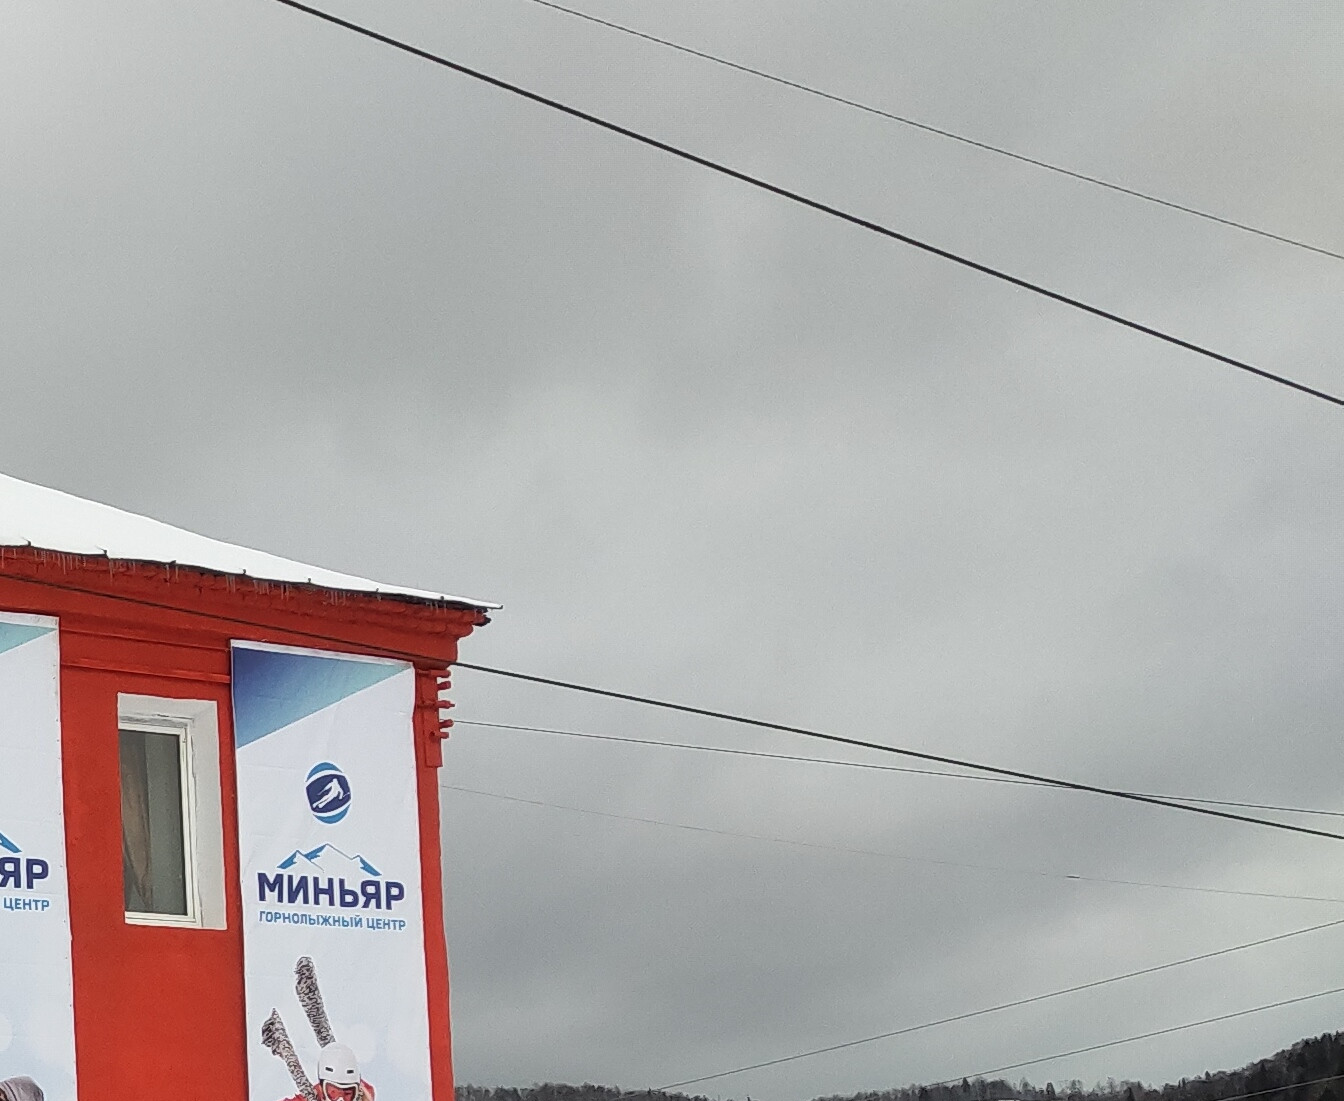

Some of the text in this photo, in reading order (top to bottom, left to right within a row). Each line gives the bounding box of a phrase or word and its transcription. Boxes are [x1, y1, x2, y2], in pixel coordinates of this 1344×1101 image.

[257, 872, 404, 910] МИНЬЯР
[3, 898, 49, 911] ЦЕНТР
[259, 911, 406, 930] ГОРНОЛЫЖНЫЙ ЦЕНТР
